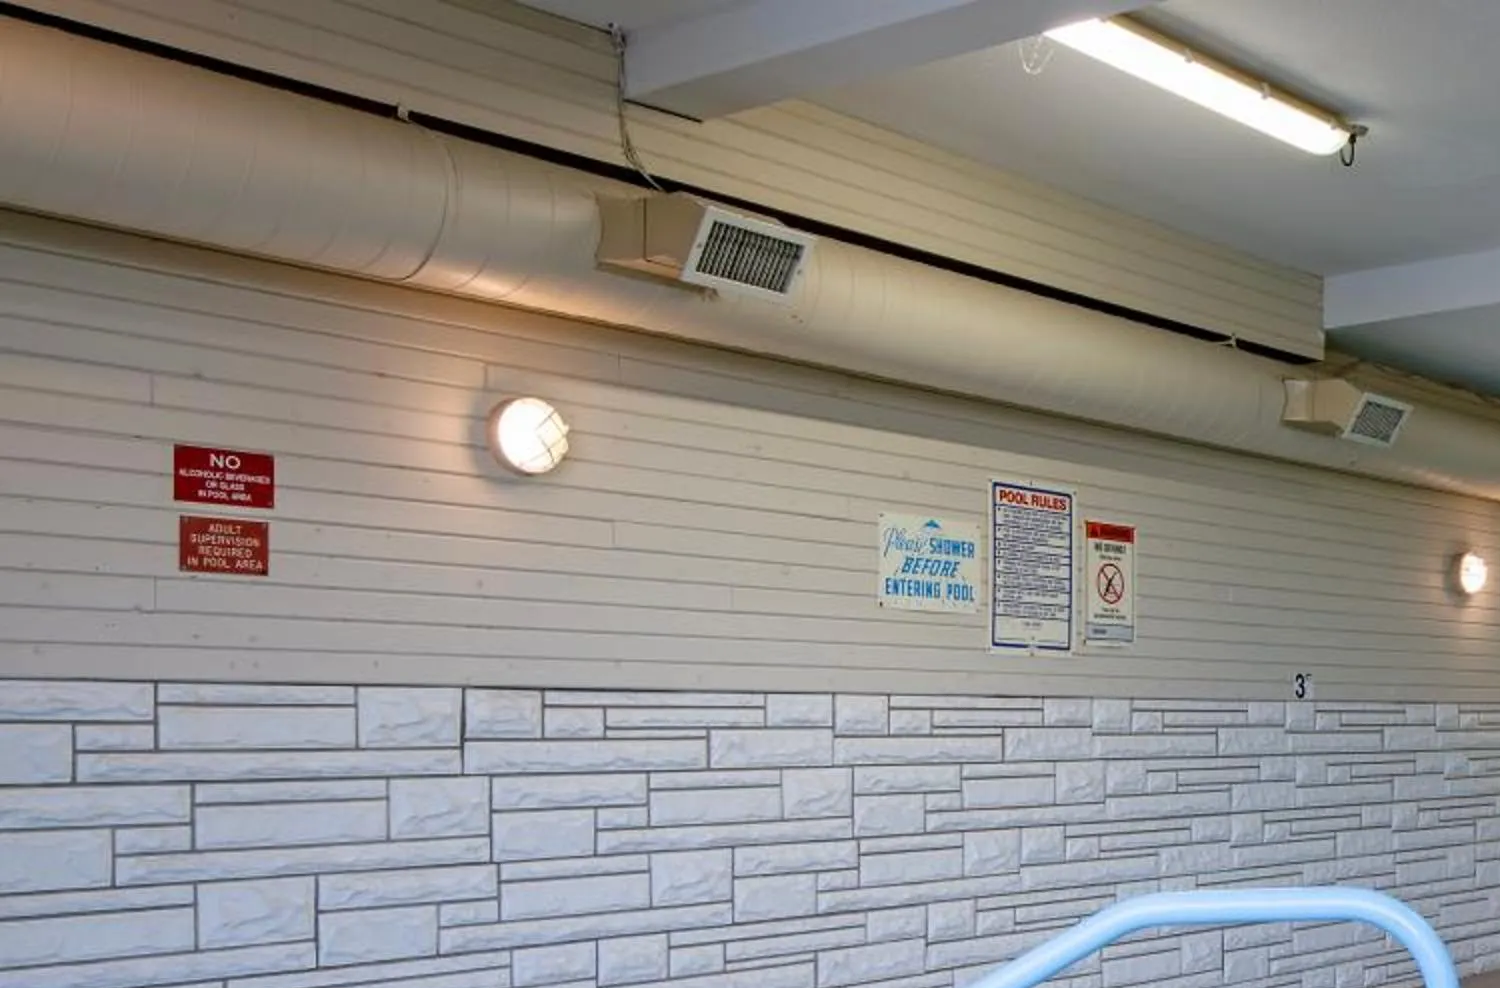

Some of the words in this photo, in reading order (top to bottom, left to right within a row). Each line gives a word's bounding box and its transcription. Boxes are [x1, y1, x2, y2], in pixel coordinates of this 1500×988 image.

[210, 454, 240, 469] NO
[208, 490, 230, 501] POOL
[999, 489, 1028, 505] POOL
[1032, 494, 1067, 511] RULES
[208, 524, 242, 534] ADULT
[190, 534, 259, 547] SUPERVISION
[929, 537, 975, 559] SHOWER
[198, 546, 252, 558] REQUIRED
[187, 555, 198, 566] IN
[203, 557, 230, 568] POOL
[235, 559, 263, 570] AREA
[901, 556, 960, 578] BEFORE
[885, 577, 941, 599] ENTERING
[946, 583, 975, 602] POOL
